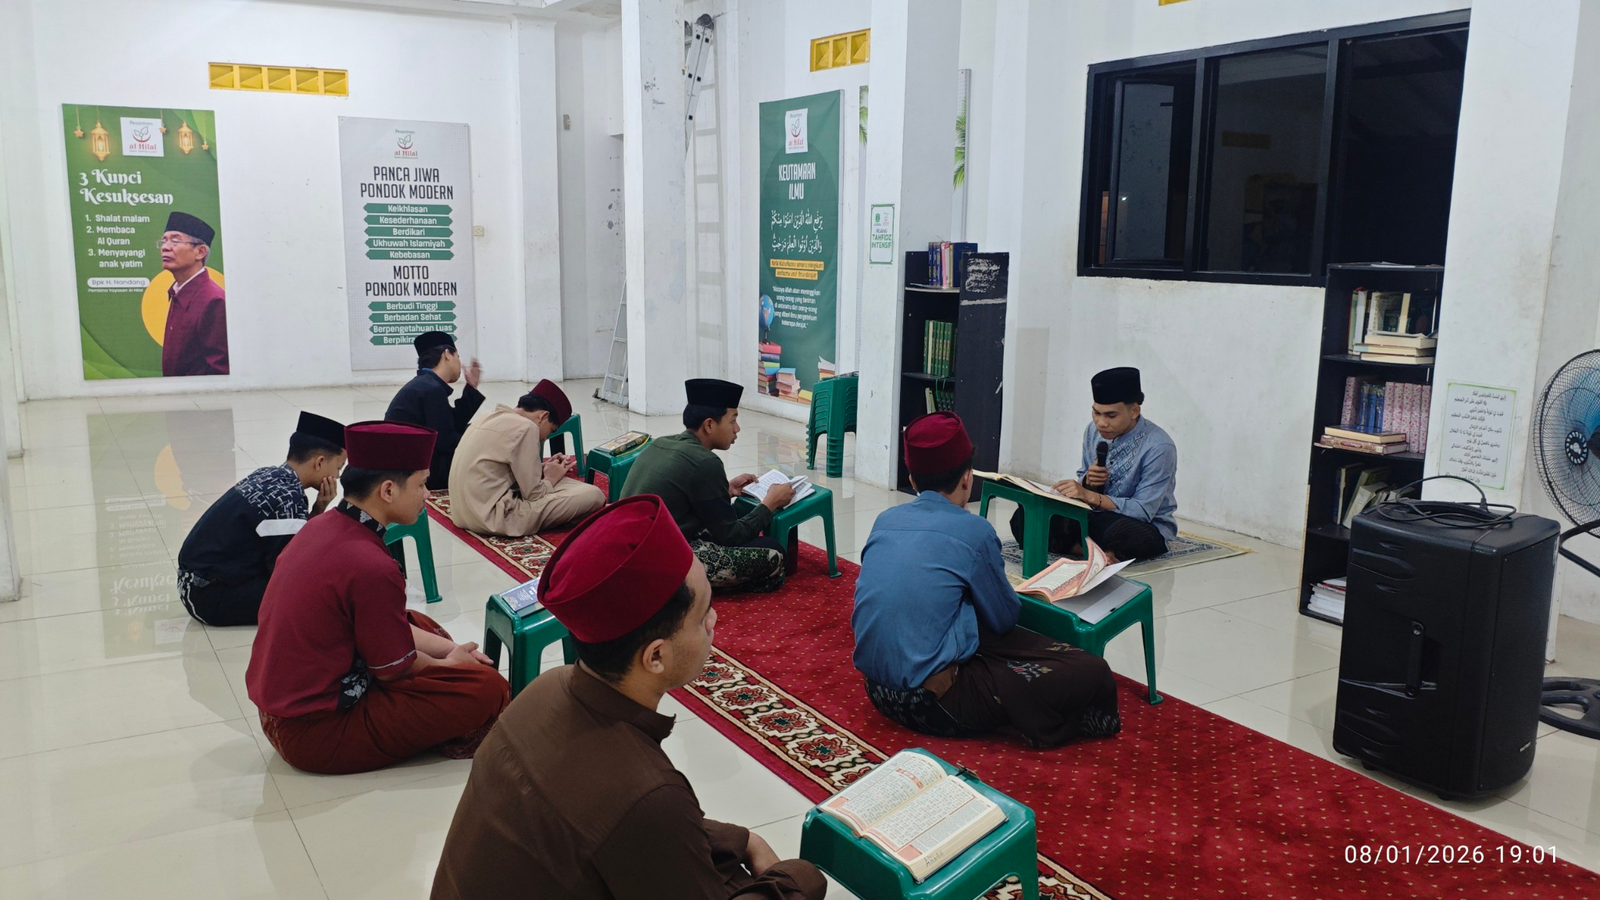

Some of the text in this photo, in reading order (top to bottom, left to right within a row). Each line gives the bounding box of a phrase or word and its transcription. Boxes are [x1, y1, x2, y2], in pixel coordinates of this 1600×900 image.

[373, 166, 440, 182] PANCA JIWA
[778, 162, 816, 181] KEUTAMAAN
[79, 169, 142, 186] 3 Kunci
[360, 183, 453, 200] PONDOK MODERN
[789, 183, 804, 200] ILMU
[80, 188, 174, 206] Kesuksesan
[388, 204, 428, 213] Keikhlasan
[95, 214, 120, 222] Shalat
[380, 216, 437, 225] Kesederhanaan
[393, 228, 425, 236] Berdikari
[106, 237, 130, 246] Quran
[410, 240, 445, 249] Islamiyah
[98, 248, 145, 258] Menyayangi
[120, 260, 143, 269] yatim
[393, 266, 429, 280] MOTTO
[365, 282, 457, 296] PONDOK MODERN
[416, 302, 438, 311] Tinggi
[373, 324, 434, 334] Berpengetahuan
[384, 336, 416, 345] Berpikira
